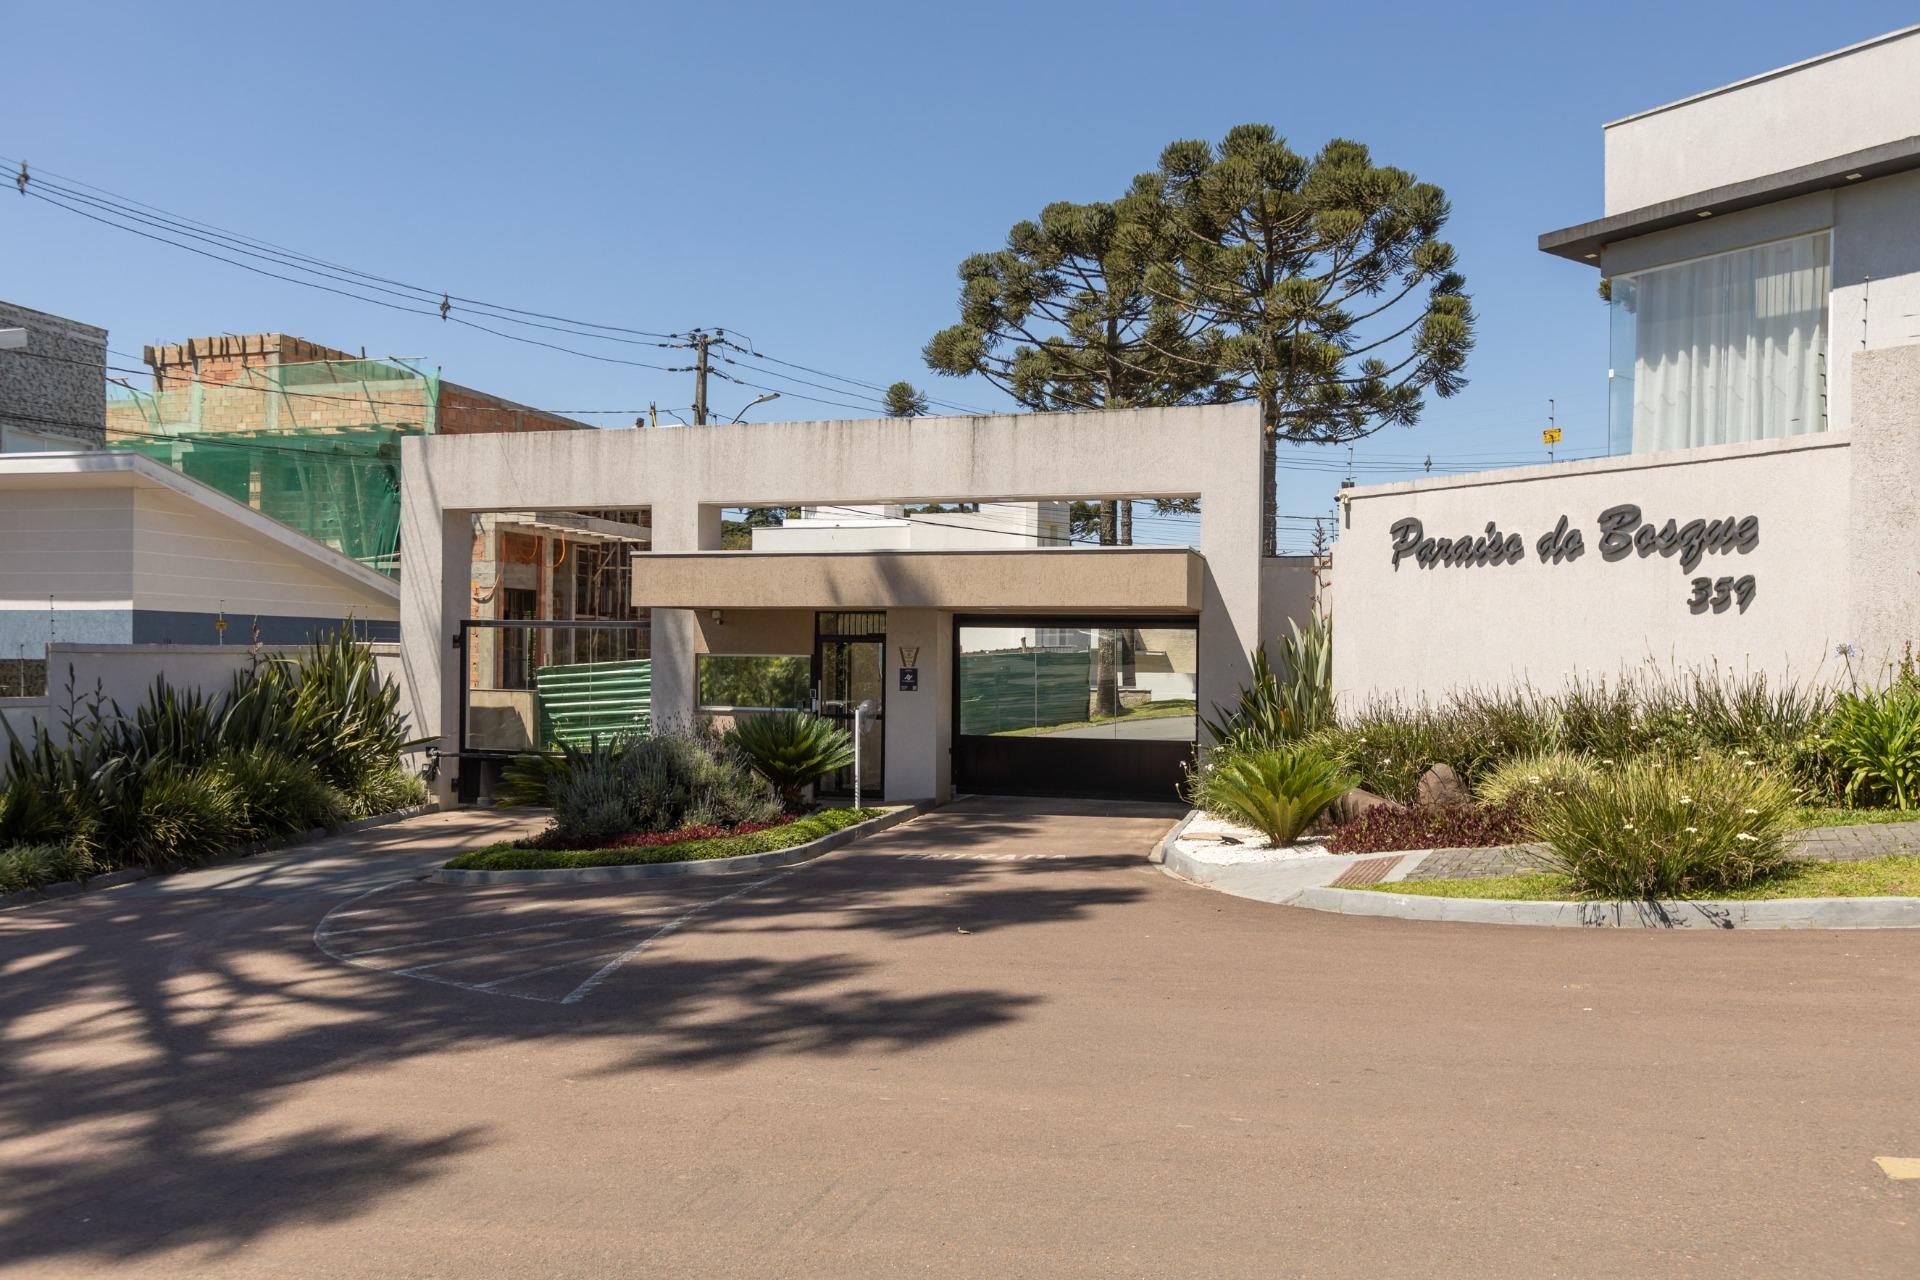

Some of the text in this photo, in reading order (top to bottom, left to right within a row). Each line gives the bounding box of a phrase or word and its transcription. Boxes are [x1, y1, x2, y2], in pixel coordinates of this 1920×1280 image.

[1536, 514, 1585, 565] do
[1597, 503, 1760, 575] Bosque
[1686, 574, 1757, 615] 359
[896, 853, 1067, 861] ENTRADA
